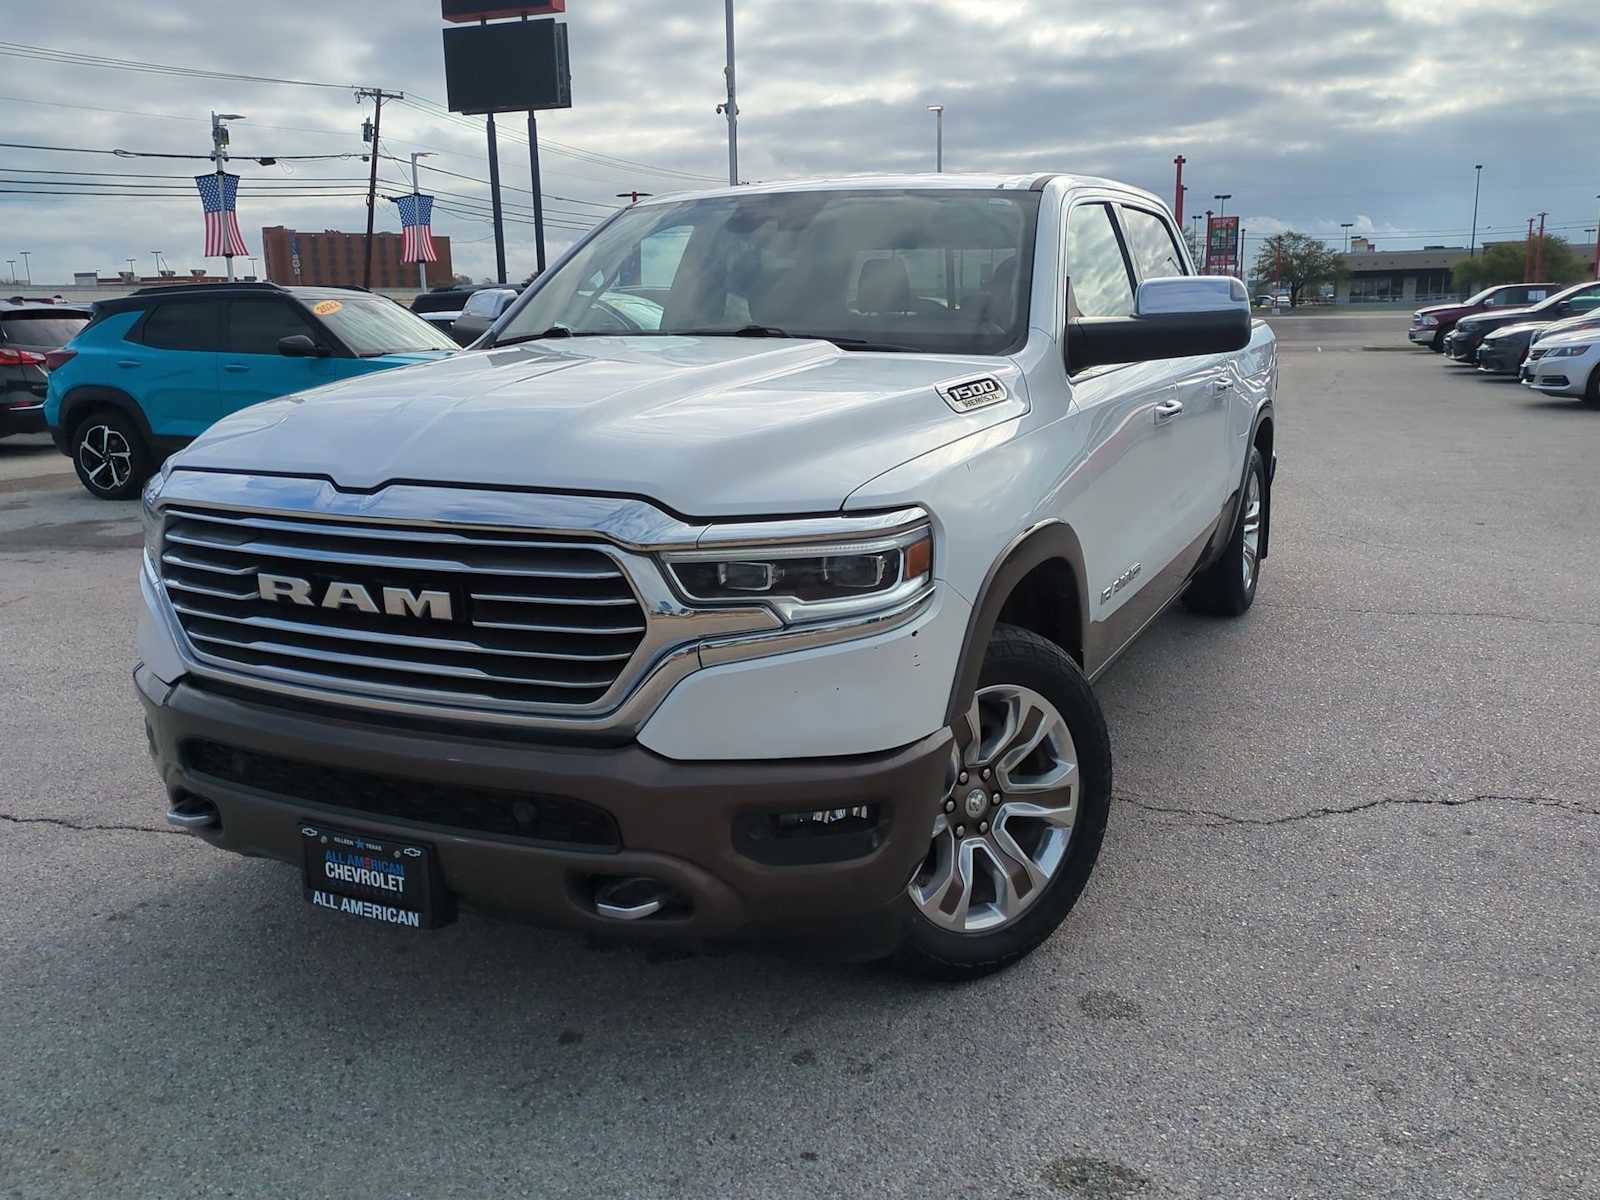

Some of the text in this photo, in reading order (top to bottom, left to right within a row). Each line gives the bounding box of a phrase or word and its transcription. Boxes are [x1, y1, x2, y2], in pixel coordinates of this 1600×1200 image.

[949, 380, 996, 400] 1500
[257, 573, 453, 620] RAM
[325, 850, 407, 875] ALL AMERICAN
[325, 861, 406, 892] CHEVROLET
[313, 890, 420, 928] ALL AMERICAN
